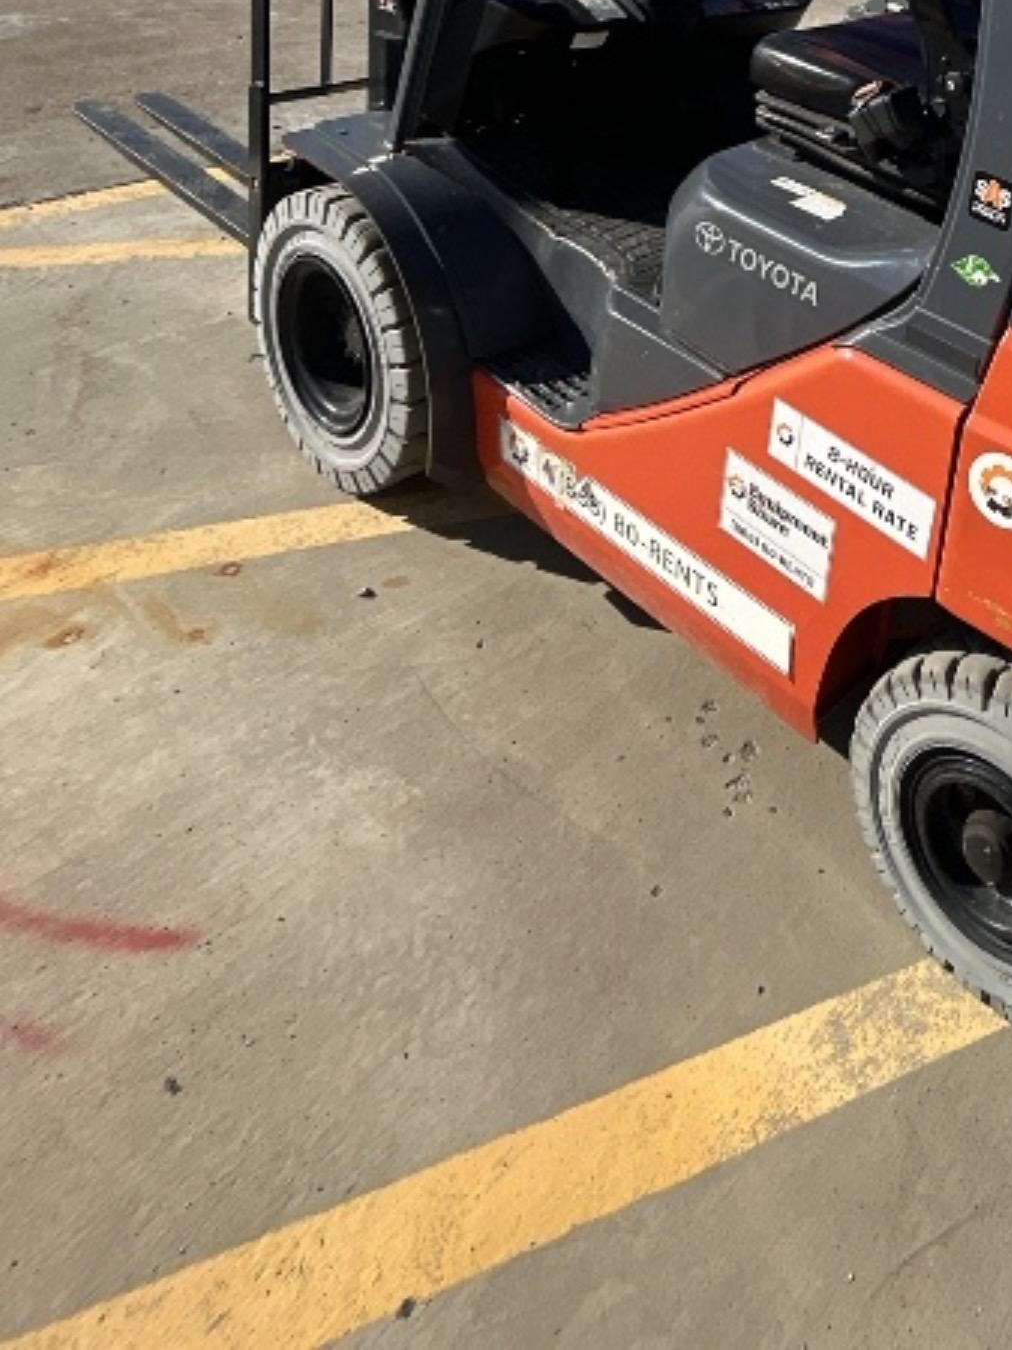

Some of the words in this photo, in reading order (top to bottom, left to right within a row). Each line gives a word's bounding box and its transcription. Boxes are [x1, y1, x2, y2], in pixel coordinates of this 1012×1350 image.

[727, 237, 819, 308] TOYOTA
[803, 453, 867, 508] RENTAL
[871, 499, 920, 542] RATE
[826, 445, 896, 500] 8-HOUR
[613, 512, 719, 608] 80-RENTS
